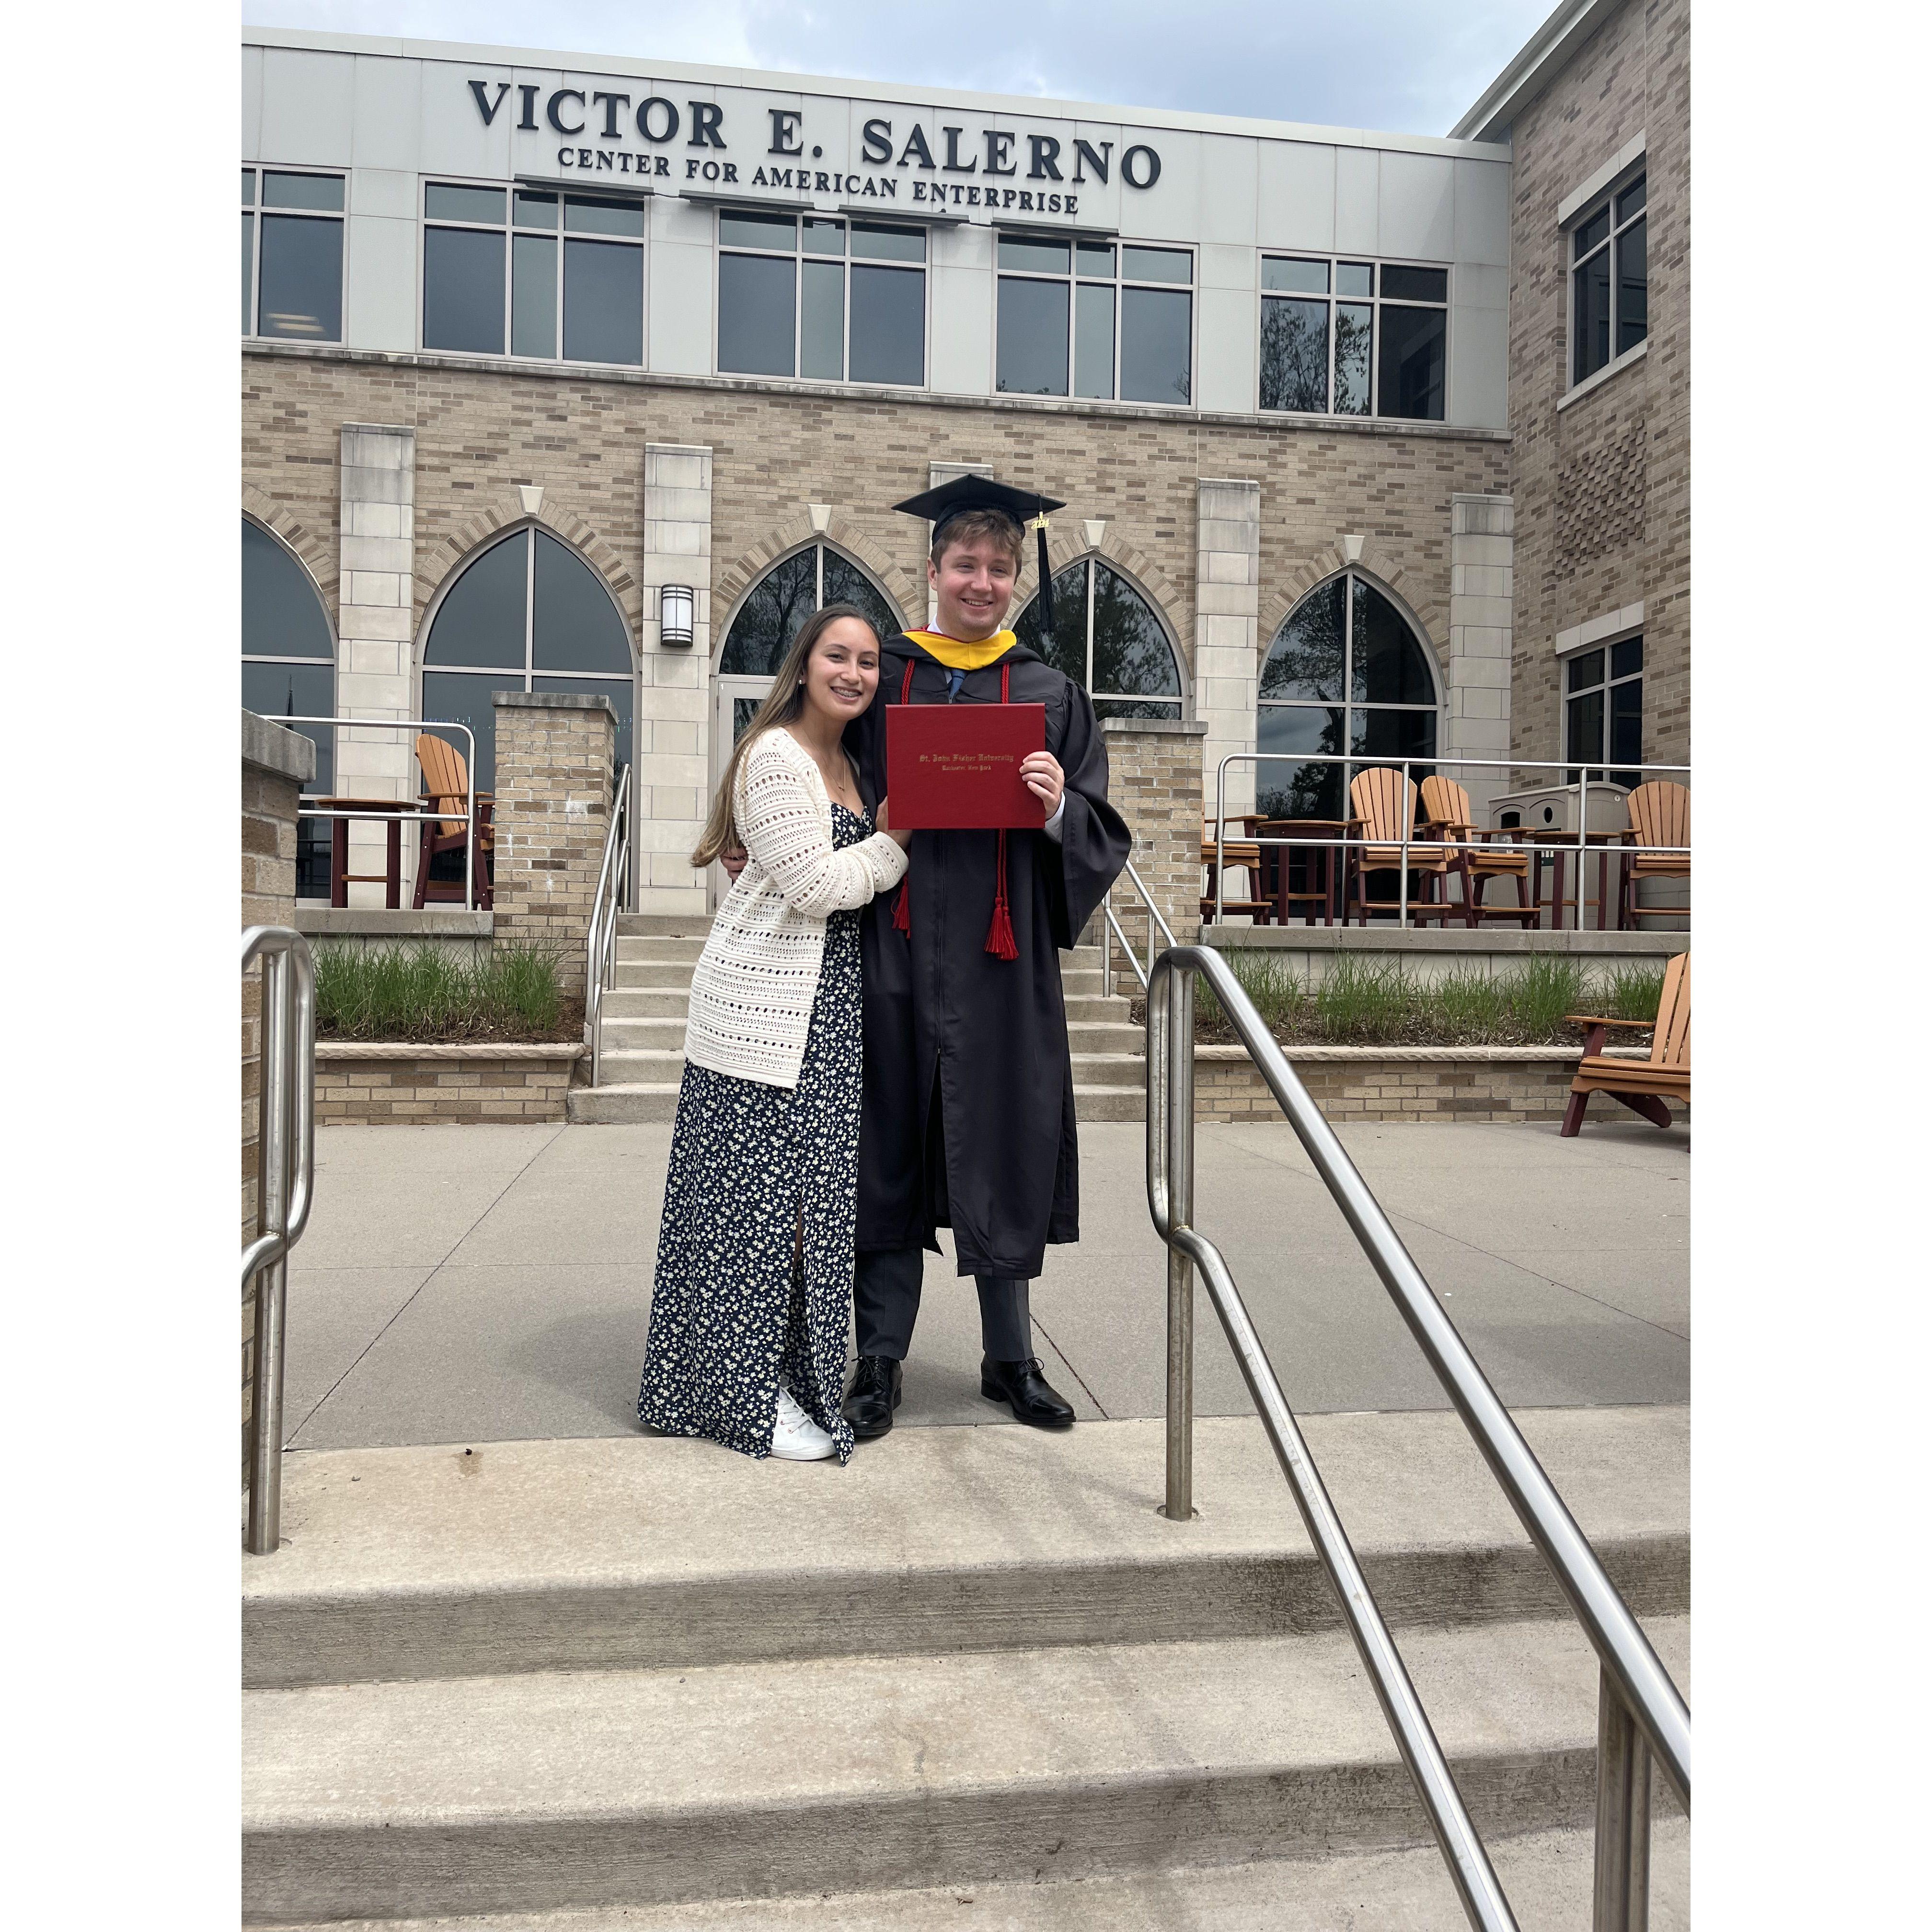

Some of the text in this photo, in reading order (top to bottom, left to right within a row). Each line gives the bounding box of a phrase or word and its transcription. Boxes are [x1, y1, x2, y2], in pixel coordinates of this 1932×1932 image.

[467, 80, 1162, 191] VICTOR E. SALERNO
[557, 147, 1079, 216] CENTER FOR AMERICAN ENTERPRISE
[919, 753, 1014, 762] St. John Fisher University
